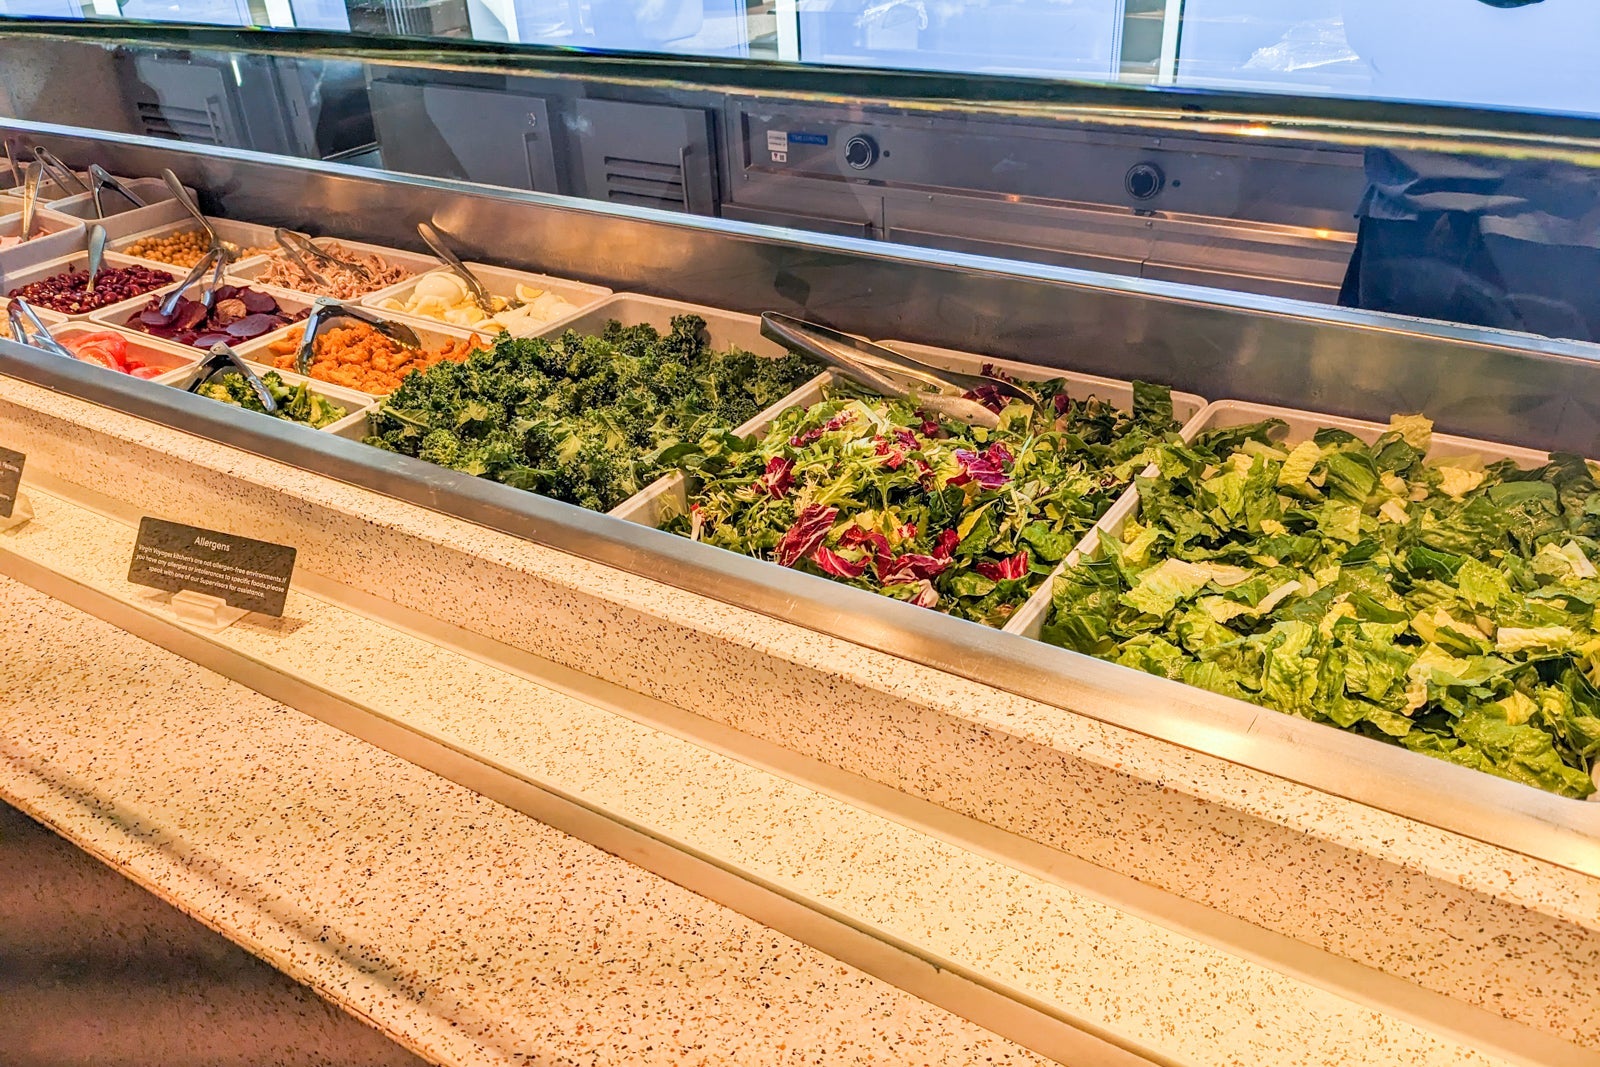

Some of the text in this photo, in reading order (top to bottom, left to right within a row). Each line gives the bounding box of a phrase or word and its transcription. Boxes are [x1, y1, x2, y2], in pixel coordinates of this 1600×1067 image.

[193, 536, 230, 552] Allergens
[138, 544, 152, 553] Virgin
[212, 562, 246, 574] allergen-free
[146, 555, 157, 563] have
[157, 559, 167, 567] any
[167, 561, 188, 570] allergies
[194, 567, 224, 579] intolerances
[231, 576, 250, 585] specific
[149, 566, 163, 574] speak
[199, 577, 228, 589] Supervisors
